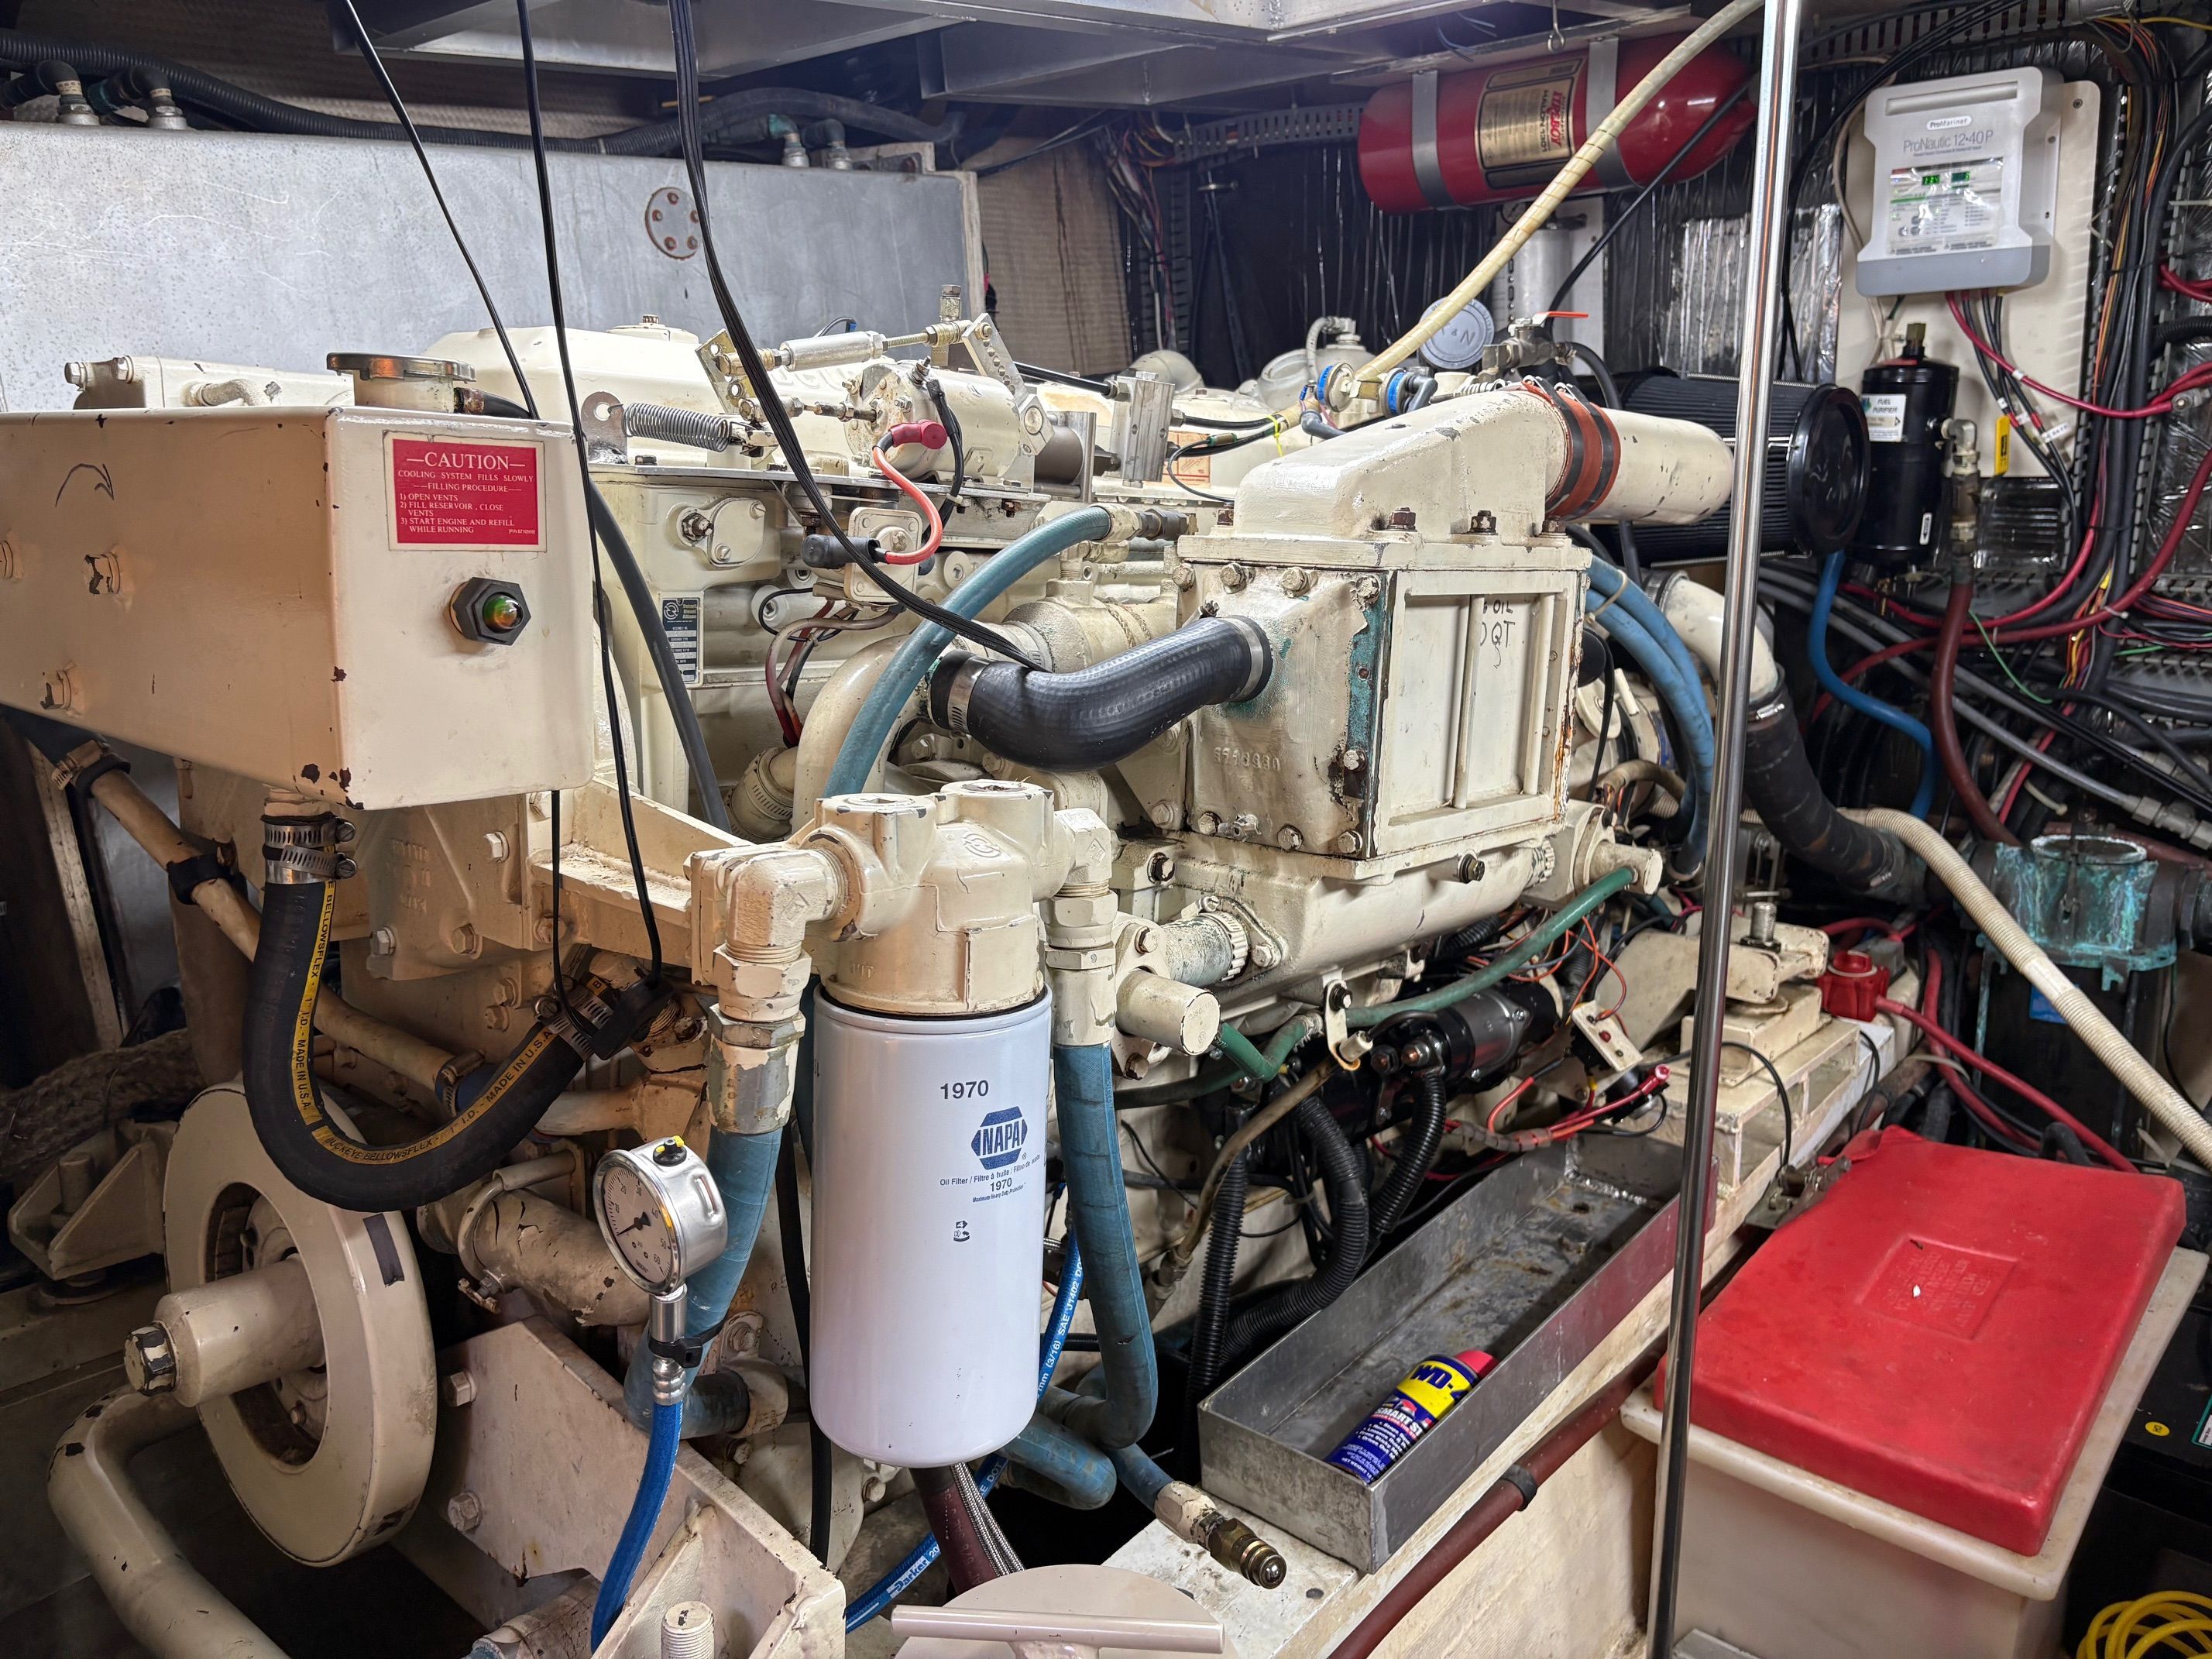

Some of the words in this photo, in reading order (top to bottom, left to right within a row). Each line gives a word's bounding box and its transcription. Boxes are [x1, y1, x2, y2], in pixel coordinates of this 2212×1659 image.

[1540, 90, 1549, 128] HALON
[1903, 135, 1951, 153] ProNautic
[398, 470, 436, 479] COOLING
[477, 473, 499, 482] FILLS
[503, 475, 534, 483] SLOWLY
[428, 483, 460, 491] FILLING
[462, 484, 509, 493] PROCEDURE
[429, 502, 472, 510] RESERVOIR
[1492, 599, 1513, 614] OIL
[311, 894, 333, 979] BELLOWSFLEX
[296, 1039, 306, 1068] MADE
[297, 1070, 306, 1081] IN
[939, 1079, 989, 1100] 1970
[324, 1136, 362, 1159] BUCKEYE
[364, 1139, 433, 1161] BELLOWSFLEX
[486, 1071, 514, 1102] MADE
[513, 1059, 527, 1072] IN
[982, 1121, 1021, 1156] NAPA
[939, 1178, 950, 1187] Oil
[951, 1176, 968, 1186] Filter
[974, 1174, 990, 1183] Filtre
[996, 1169, 1010, 1179] huile
[1013, 1163, 1025, 1173] Filtro
[620, 1182, 627, 1195] 20
[635, 1184, 642, 1197] 30
[990, 1177, 1012, 1192] 1970
[972, 1194, 991, 1203] Maximum
[991, 1191, 1001, 1200] Heavy
[651, 1207, 659, 1219] 40
[660, 1238, 667, 1250] 50
[653, 1253, 661, 1266] 60
[1046, 1341, 1062, 1368] (3/16)
[1058, 1315, 1070, 1336] SAE
[1066, 1280, 1080, 1310] J1402
[1410, 1364, 1468, 1400] WD-4
[1374, 1407, 1413, 1426] SMART
[986, 1461, 1002, 1482] DOT
[888, 1557, 929, 1594] Parker
